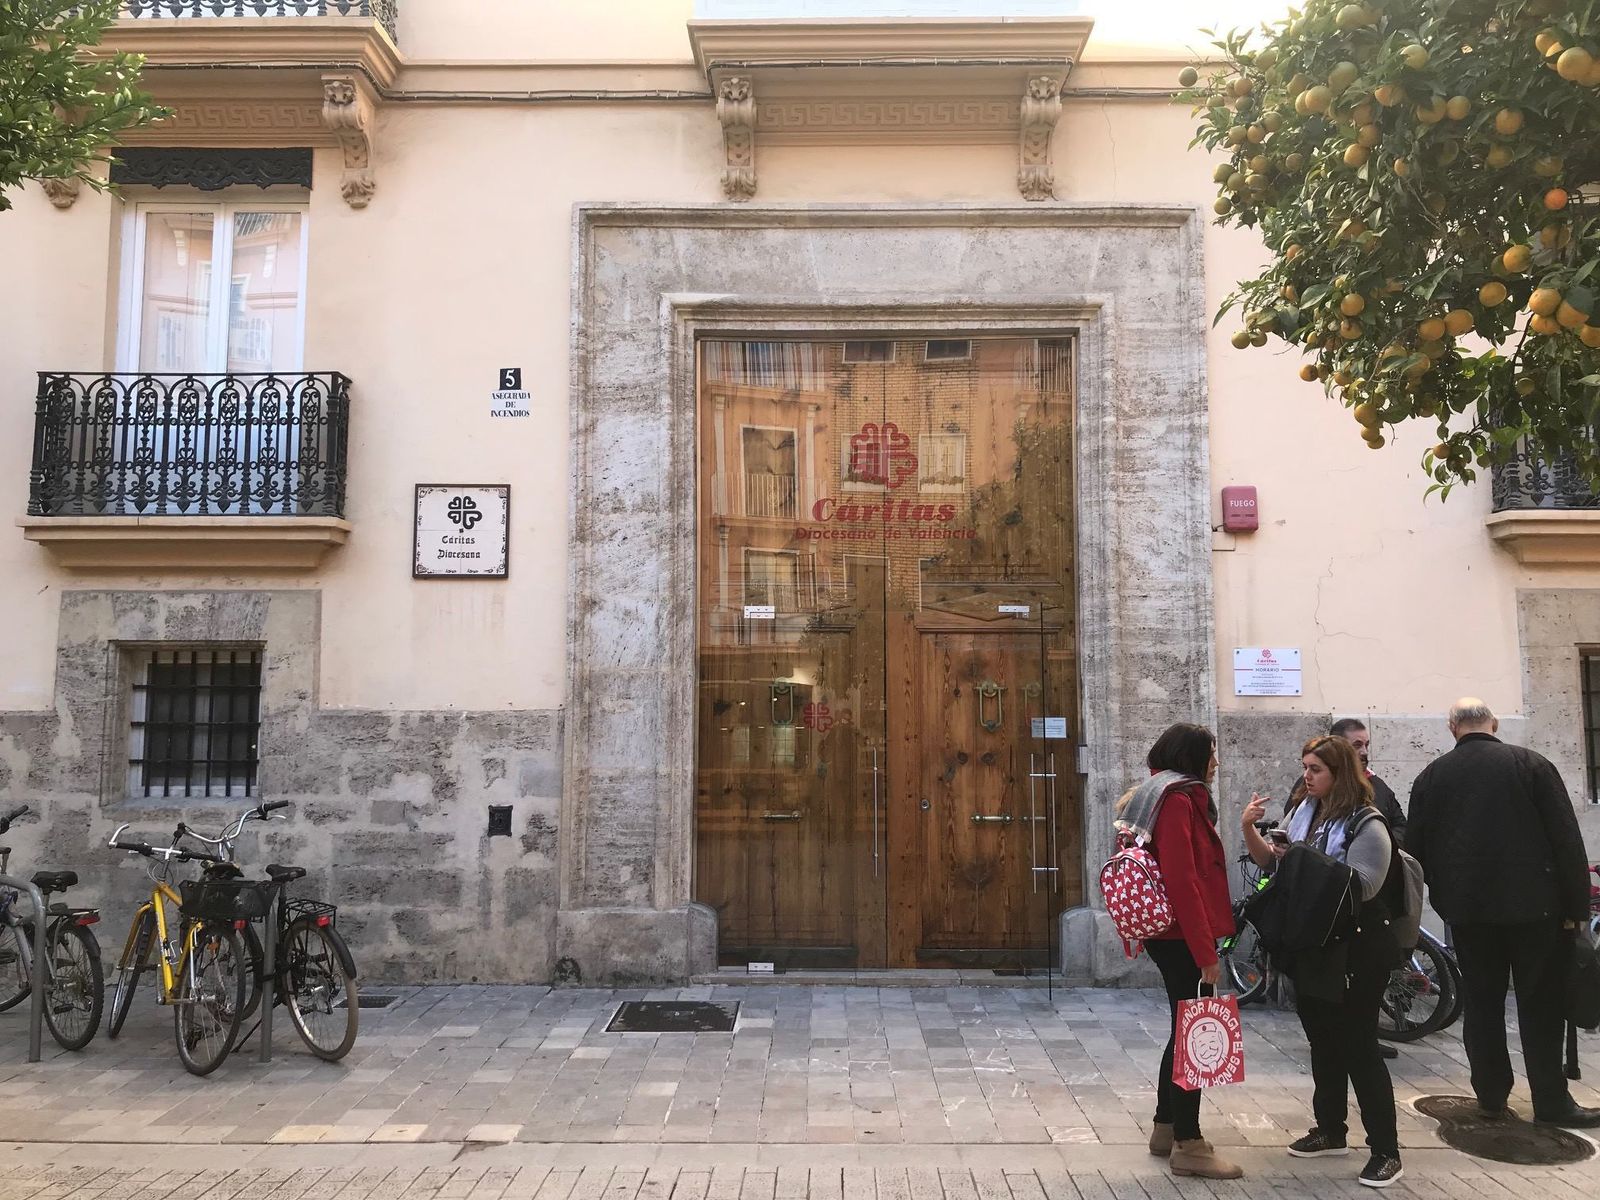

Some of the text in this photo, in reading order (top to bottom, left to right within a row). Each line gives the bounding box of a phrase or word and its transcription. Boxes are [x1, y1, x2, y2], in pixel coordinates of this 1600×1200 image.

[505, 369, 515, 387] 5
[491, 392, 531, 400] ASEGURADA
[1230, 499, 1255, 507] FUEGO
[812, 498, 956, 522] Cáritas
[794, 527, 876, 540] Diocesana
[884, 527, 902, 540] de
[441, 535, 476, 545] Cáritas
[437, 549, 481, 559] Diocesana
[1232, 1041, 1244, 1054] EL
